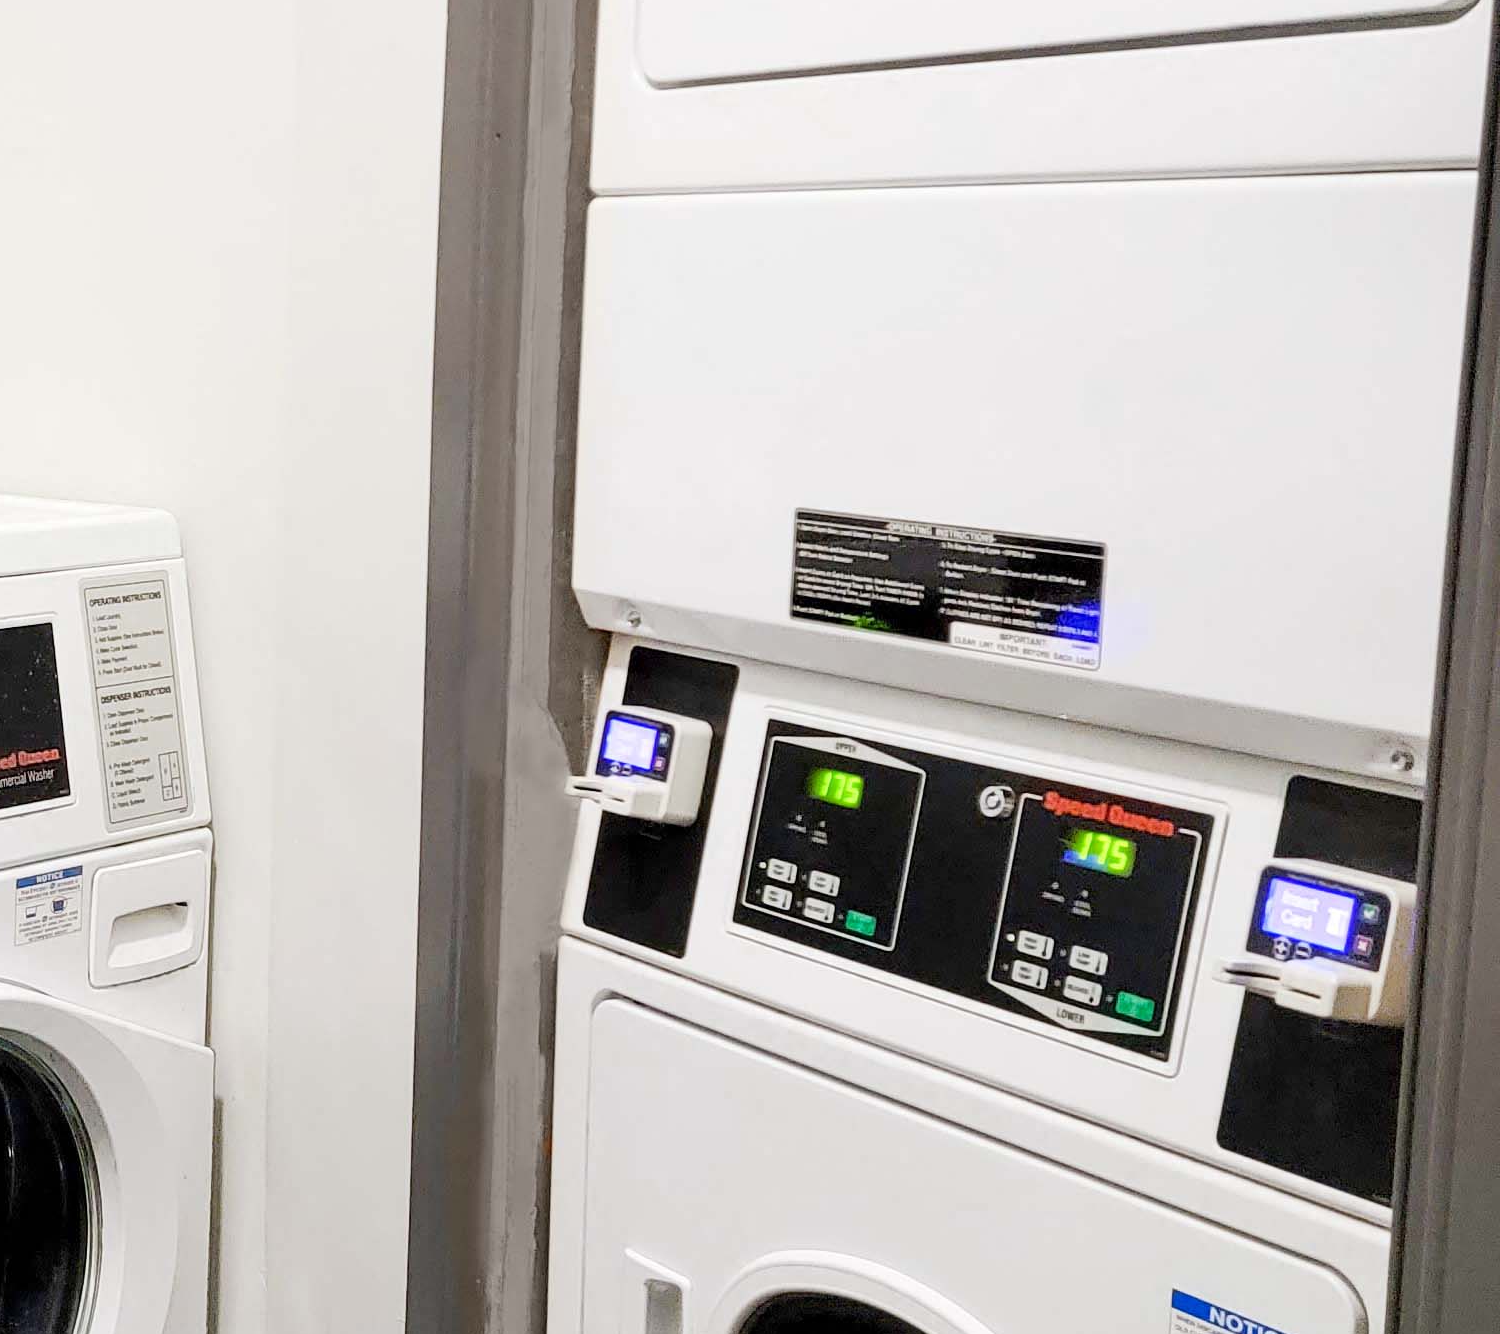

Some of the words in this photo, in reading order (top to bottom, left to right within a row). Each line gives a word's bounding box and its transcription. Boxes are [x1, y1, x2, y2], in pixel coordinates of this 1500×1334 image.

[18, 748, 60, 766] Queen
[27, 769, 54, 782] Washer
[819, 771, 862, 804] 175
[1043, 791, 1108, 821] Speed
[1109, 805, 1175, 837] Queen
[1078, 833, 1129, 870] 175
[36, 870, 64, 883] NOTICE
[1056, 1008, 1085, 1024] LOWER
